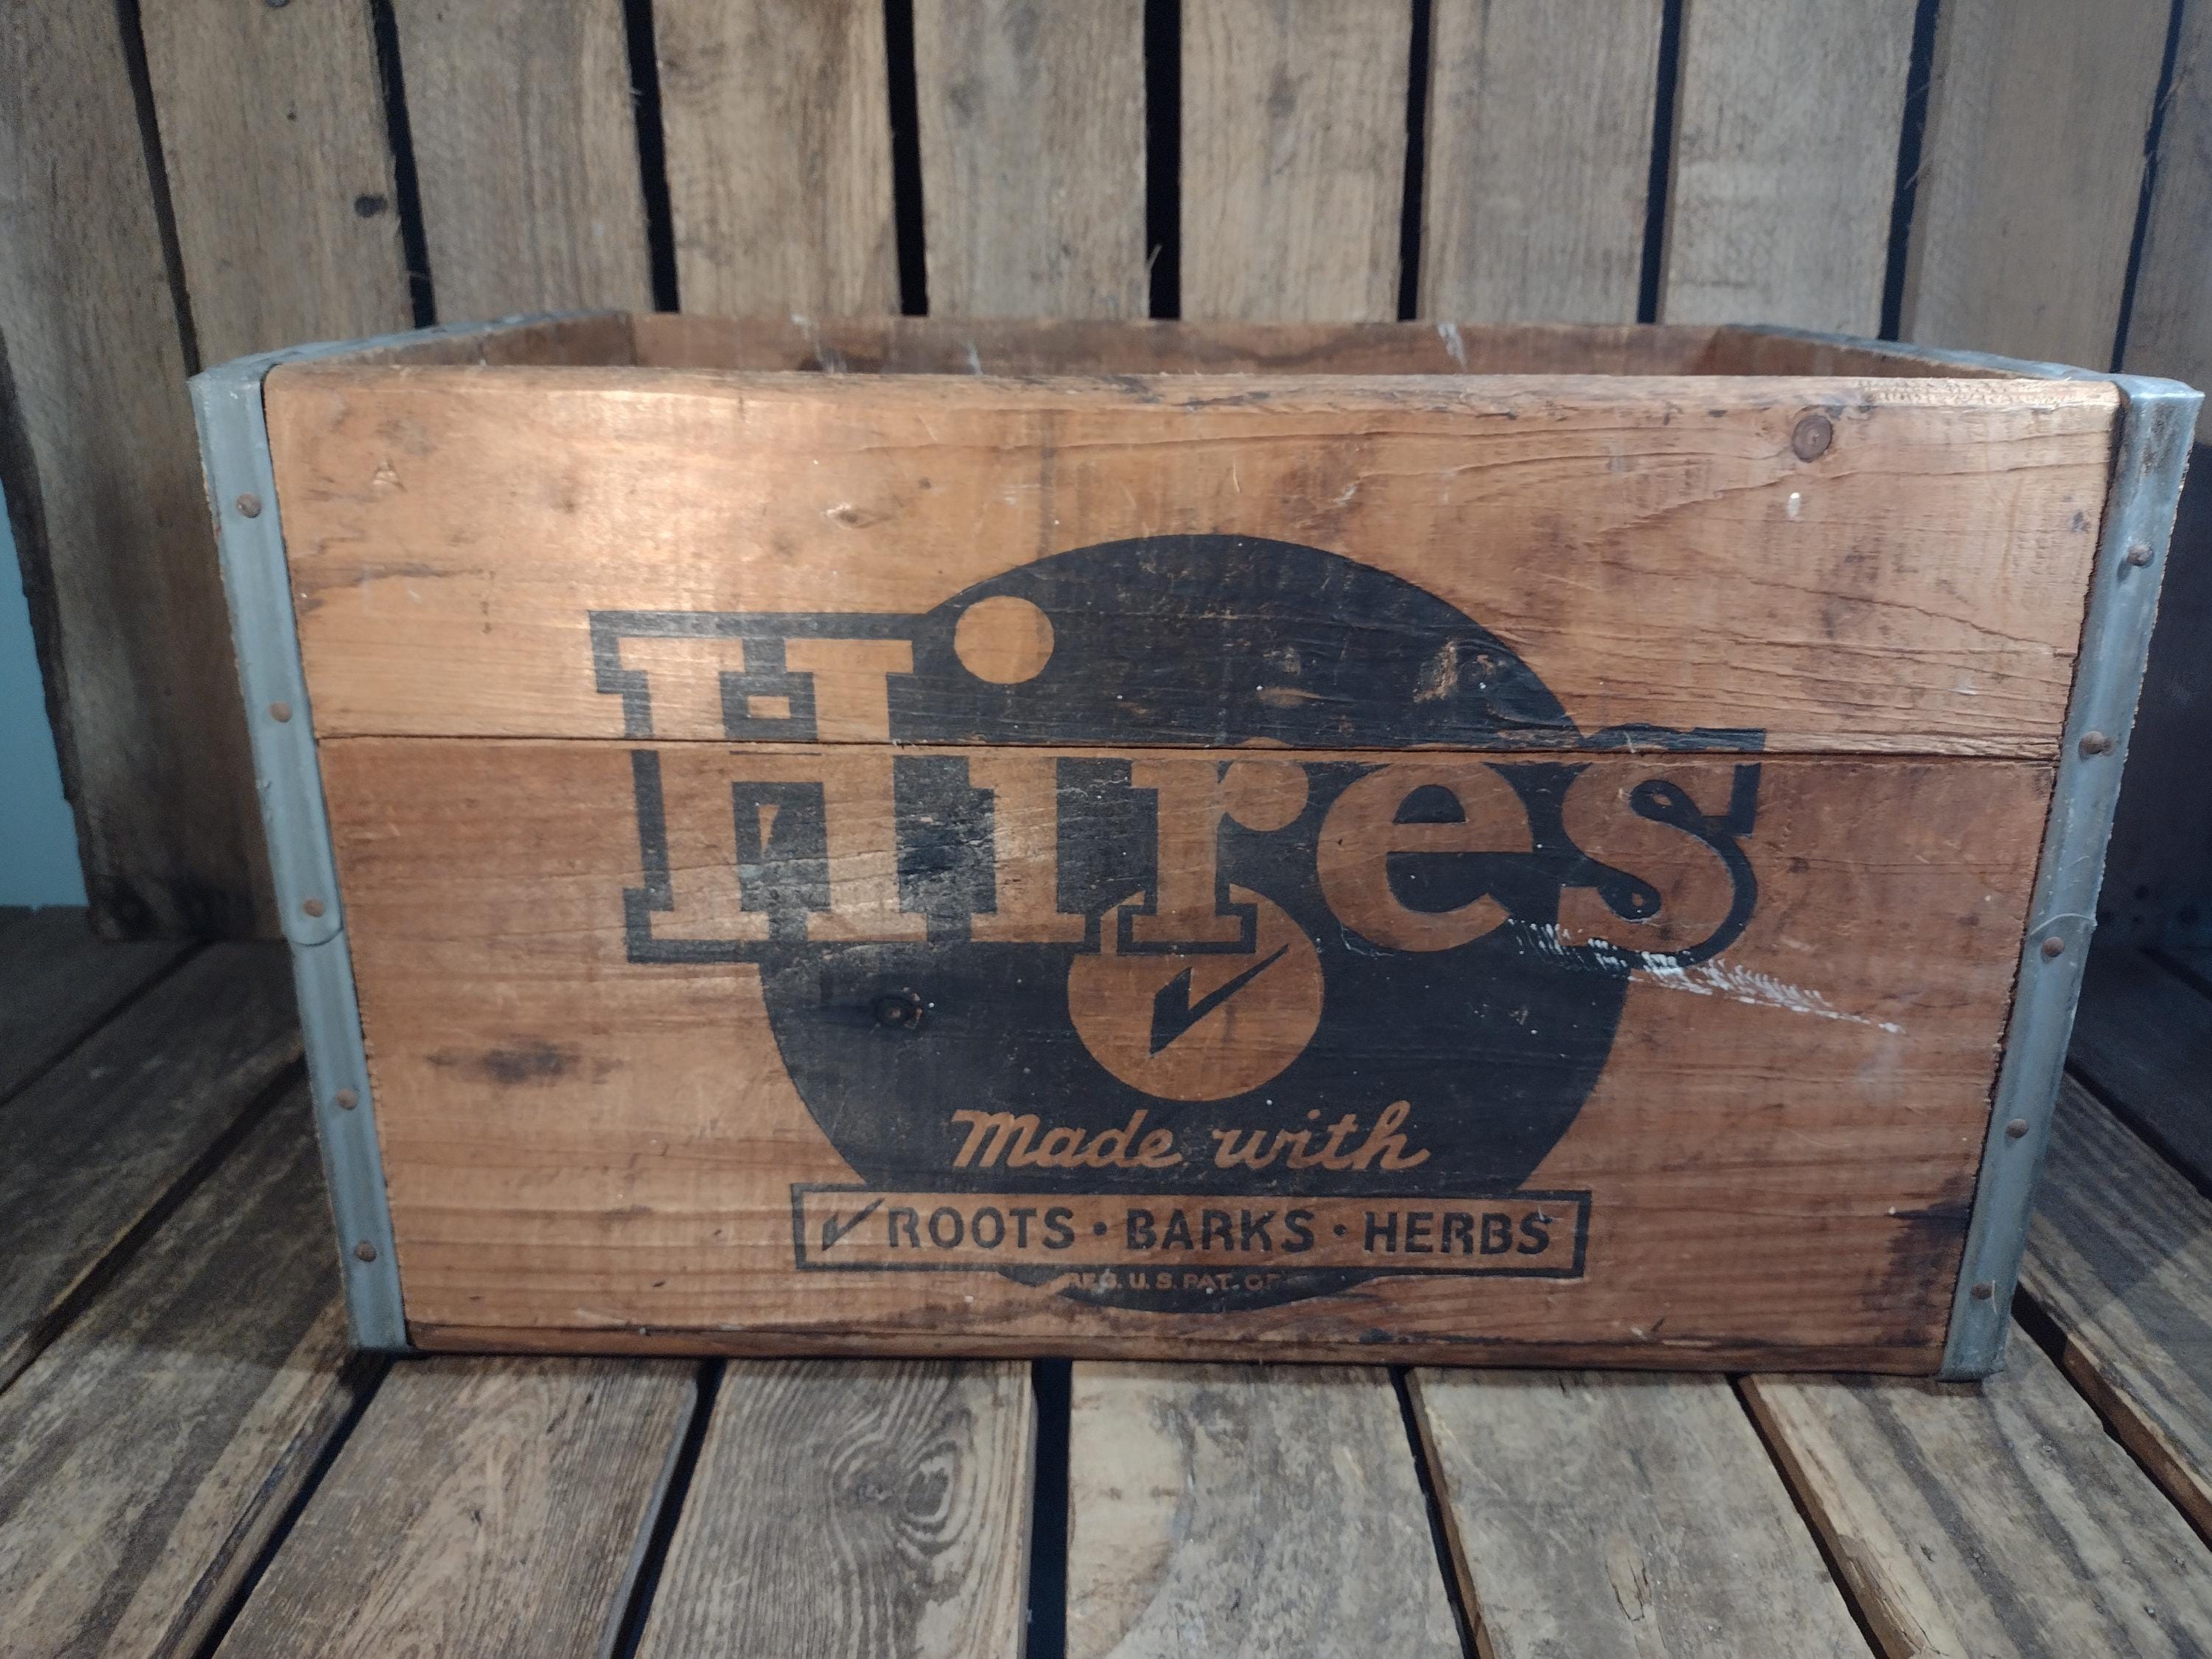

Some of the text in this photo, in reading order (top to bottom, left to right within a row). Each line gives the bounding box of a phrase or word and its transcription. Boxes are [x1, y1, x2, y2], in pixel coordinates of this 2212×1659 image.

[590, 596, 1767, 966] Hires
[952, 1100, 1430, 1170] Made with
[888, 1206, 1553, 1255] ROOTS BARKS HERBS
